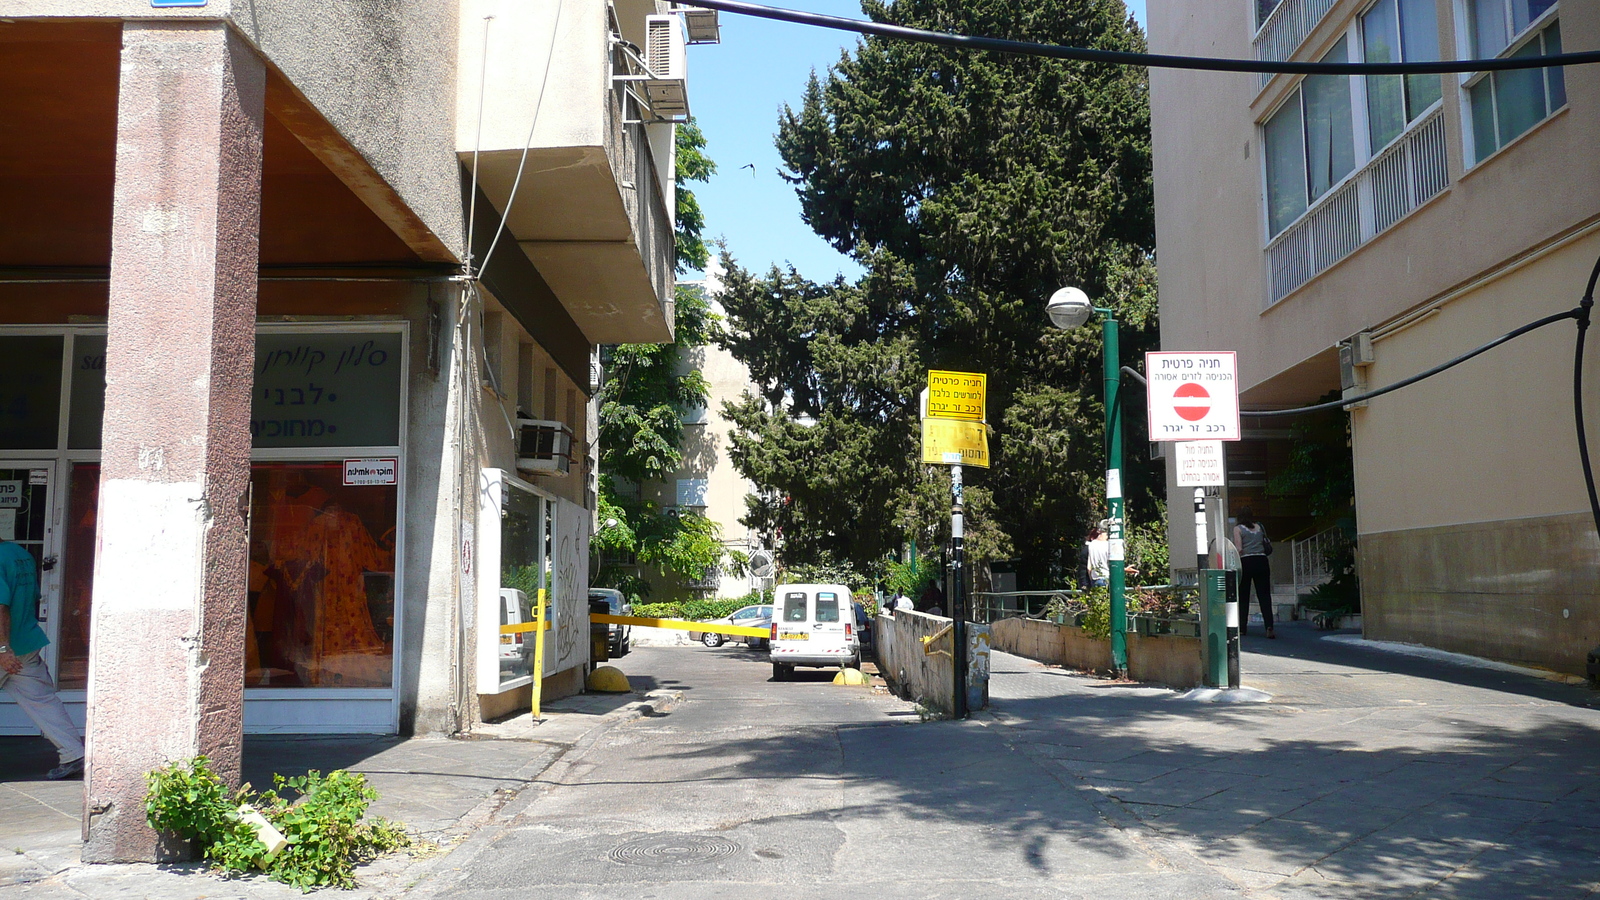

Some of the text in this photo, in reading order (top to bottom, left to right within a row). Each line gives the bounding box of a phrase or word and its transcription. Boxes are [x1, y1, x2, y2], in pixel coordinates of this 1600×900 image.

[334, 340, 388, 375] סלון
[1162, 358, 1221, 369] חניה פרטית
[1154, 371, 1233, 381] הכניסה לזרים אסורה
[932, 377, 982, 387] חניה פרטית
[264, 382, 324, 406] לבני
[932, 388, 982, 400] למורשים בלבד
[952, 403, 961, 411] זר
[965, 404, 982, 412] רכב
[1163, 424, 1226, 433] רכב זר יגרר
